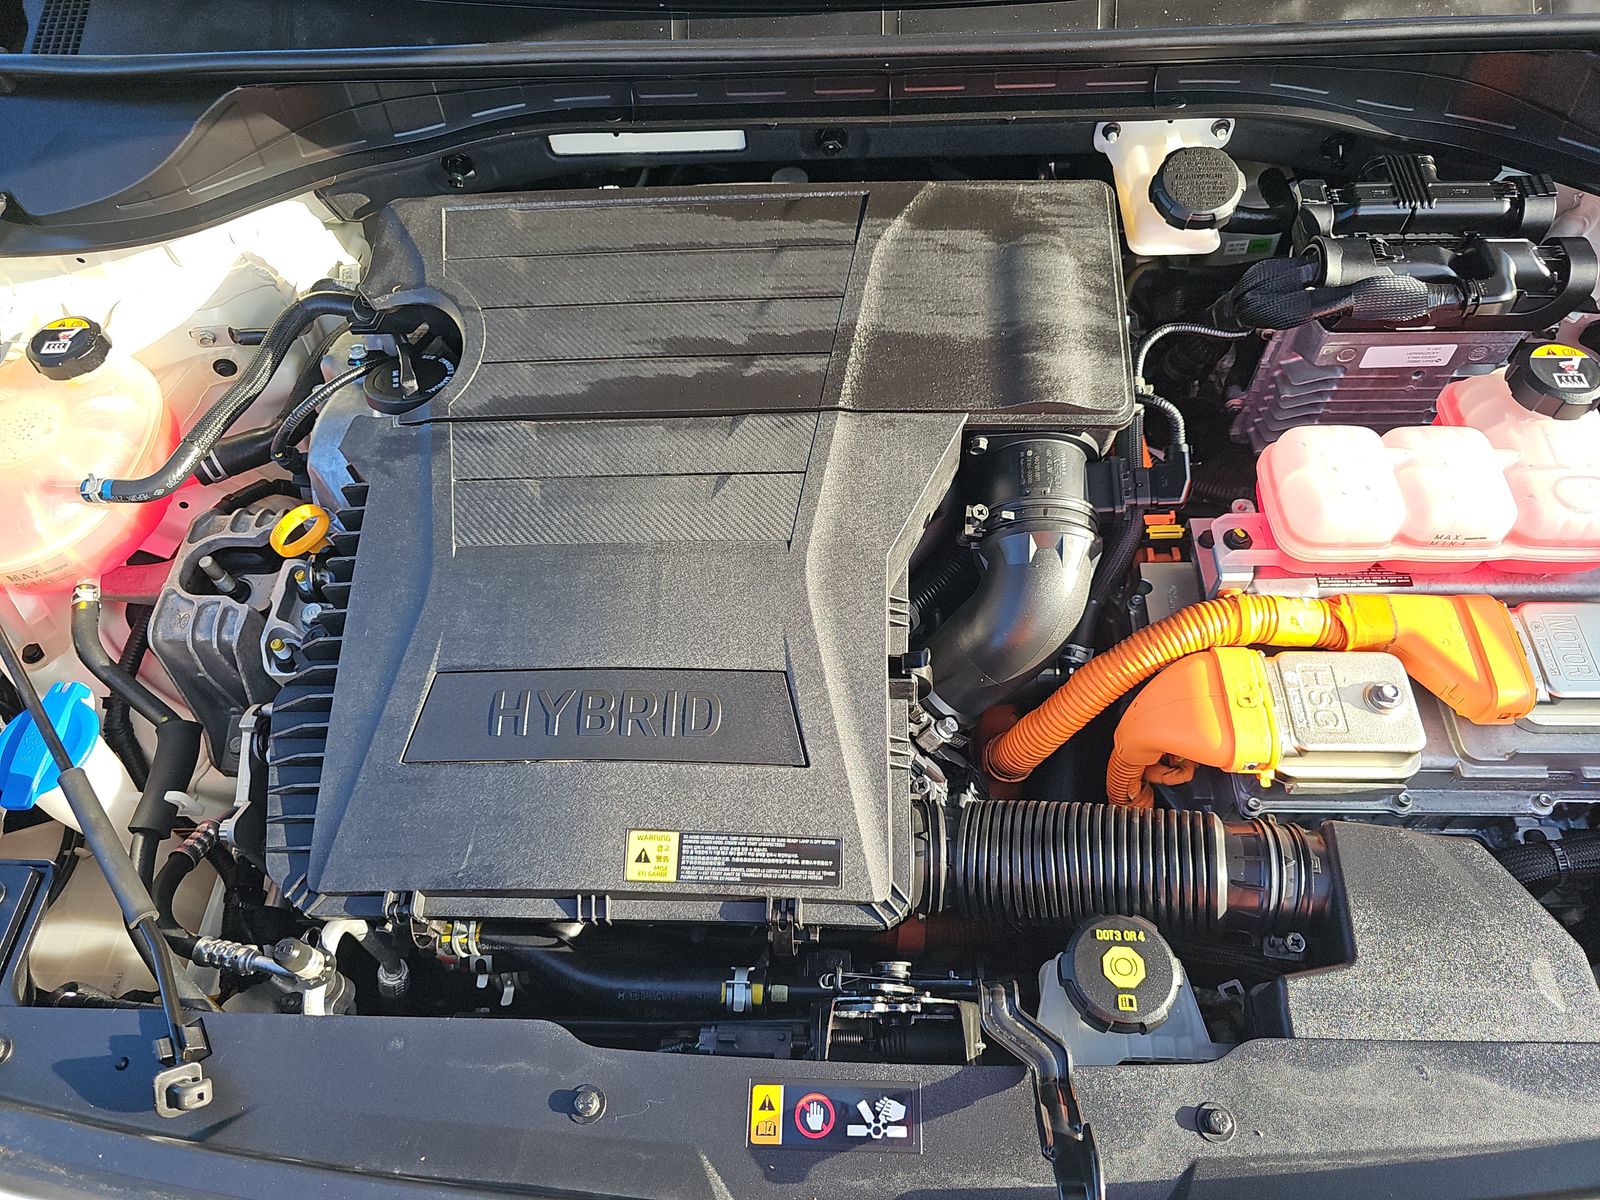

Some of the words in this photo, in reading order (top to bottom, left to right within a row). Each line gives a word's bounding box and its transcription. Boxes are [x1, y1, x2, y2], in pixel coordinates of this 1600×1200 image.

[425, 376, 452, 393] MANUAL
[6, 570, 42, 582] MAX
[1547, 619, 1593, 676] MOTOR
[1301, 669, 1339, 727] HSG
[488, 690, 722, 737] HYBRID
[637, 834, 671, 842] WARNING
[1095, 929, 1122, 941] DOT3
[1123, 930, 1137, 942] OR
[1138, 930, 1146, 942] 4
